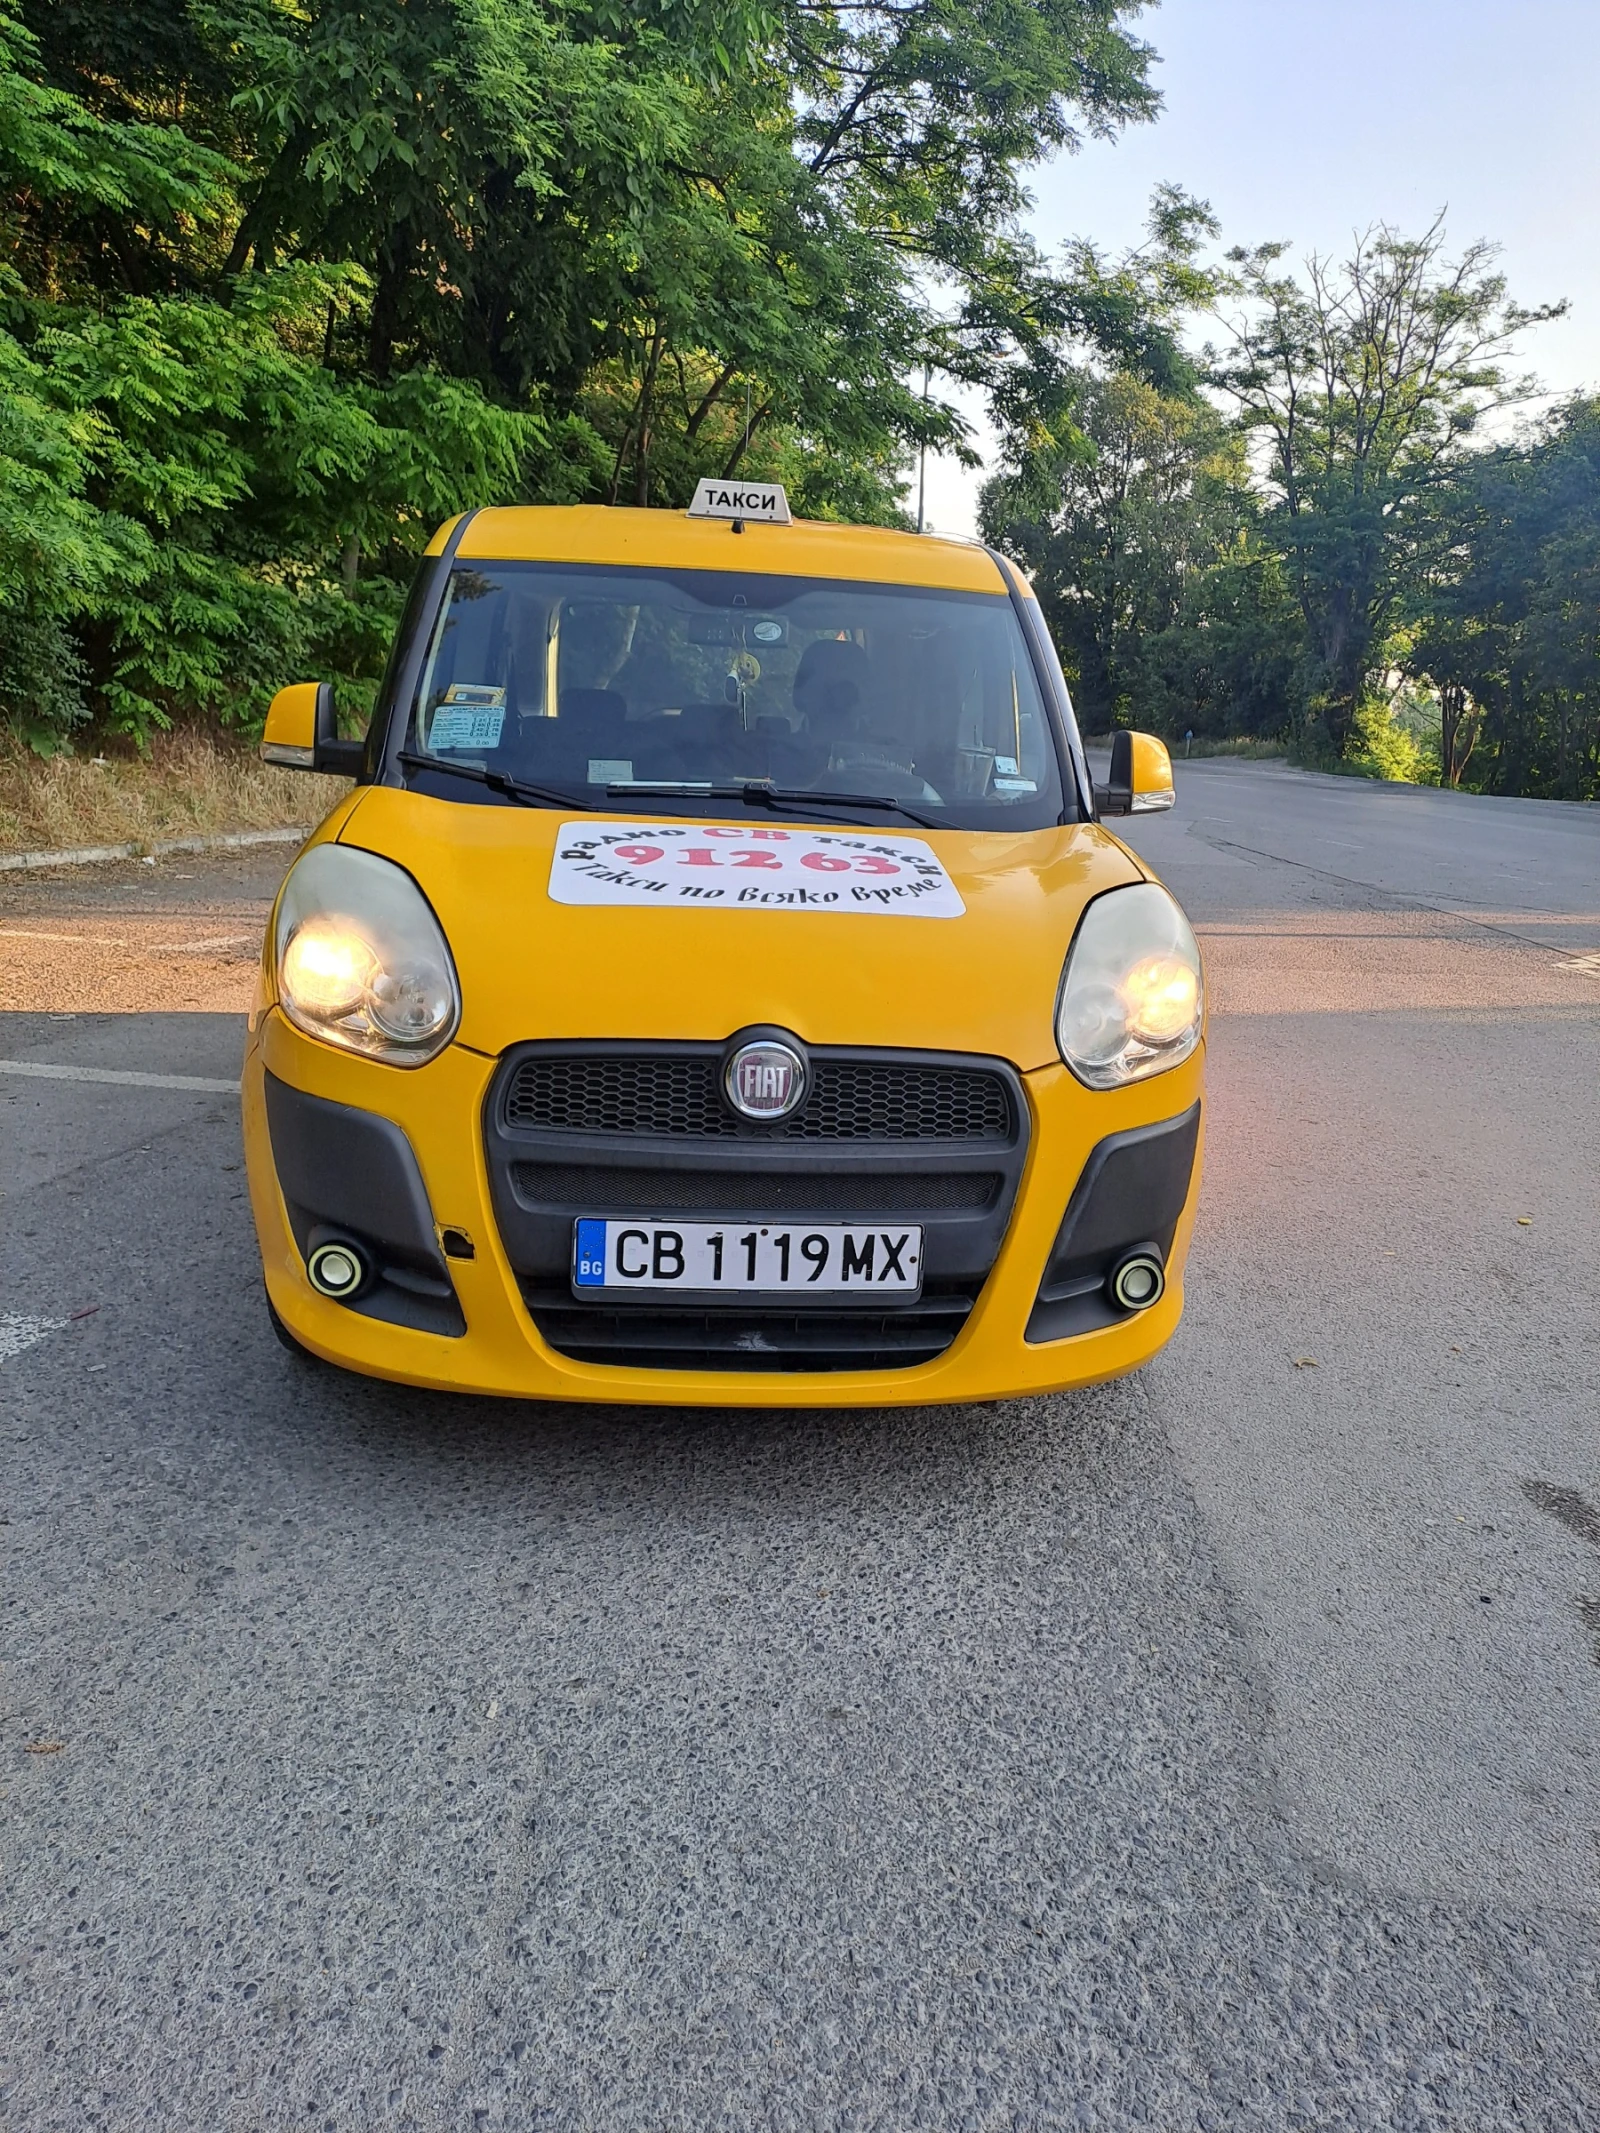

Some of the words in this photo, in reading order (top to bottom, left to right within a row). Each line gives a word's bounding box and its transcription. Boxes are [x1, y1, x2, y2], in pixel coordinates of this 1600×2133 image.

[705, 490, 776, 511] ТАКСИ
[560, 829, 687, 860] радио
[702, 828, 791, 841] СВ
[812, 836, 943, 876] такси
[572, 863, 670, 892] Такси
[679, 886, 725, 899] по
[737, 887, 839, 904] всяко
[850, 878, 942, 904] време
[743, 1064, 789, 1098] FIAT
[580, 1260, 603, 1276] BG
[615, 1229, 686, 1280] CB
[706, 1232, 830, 1282] 1119
[841, 1233, 909, 1282] MX
